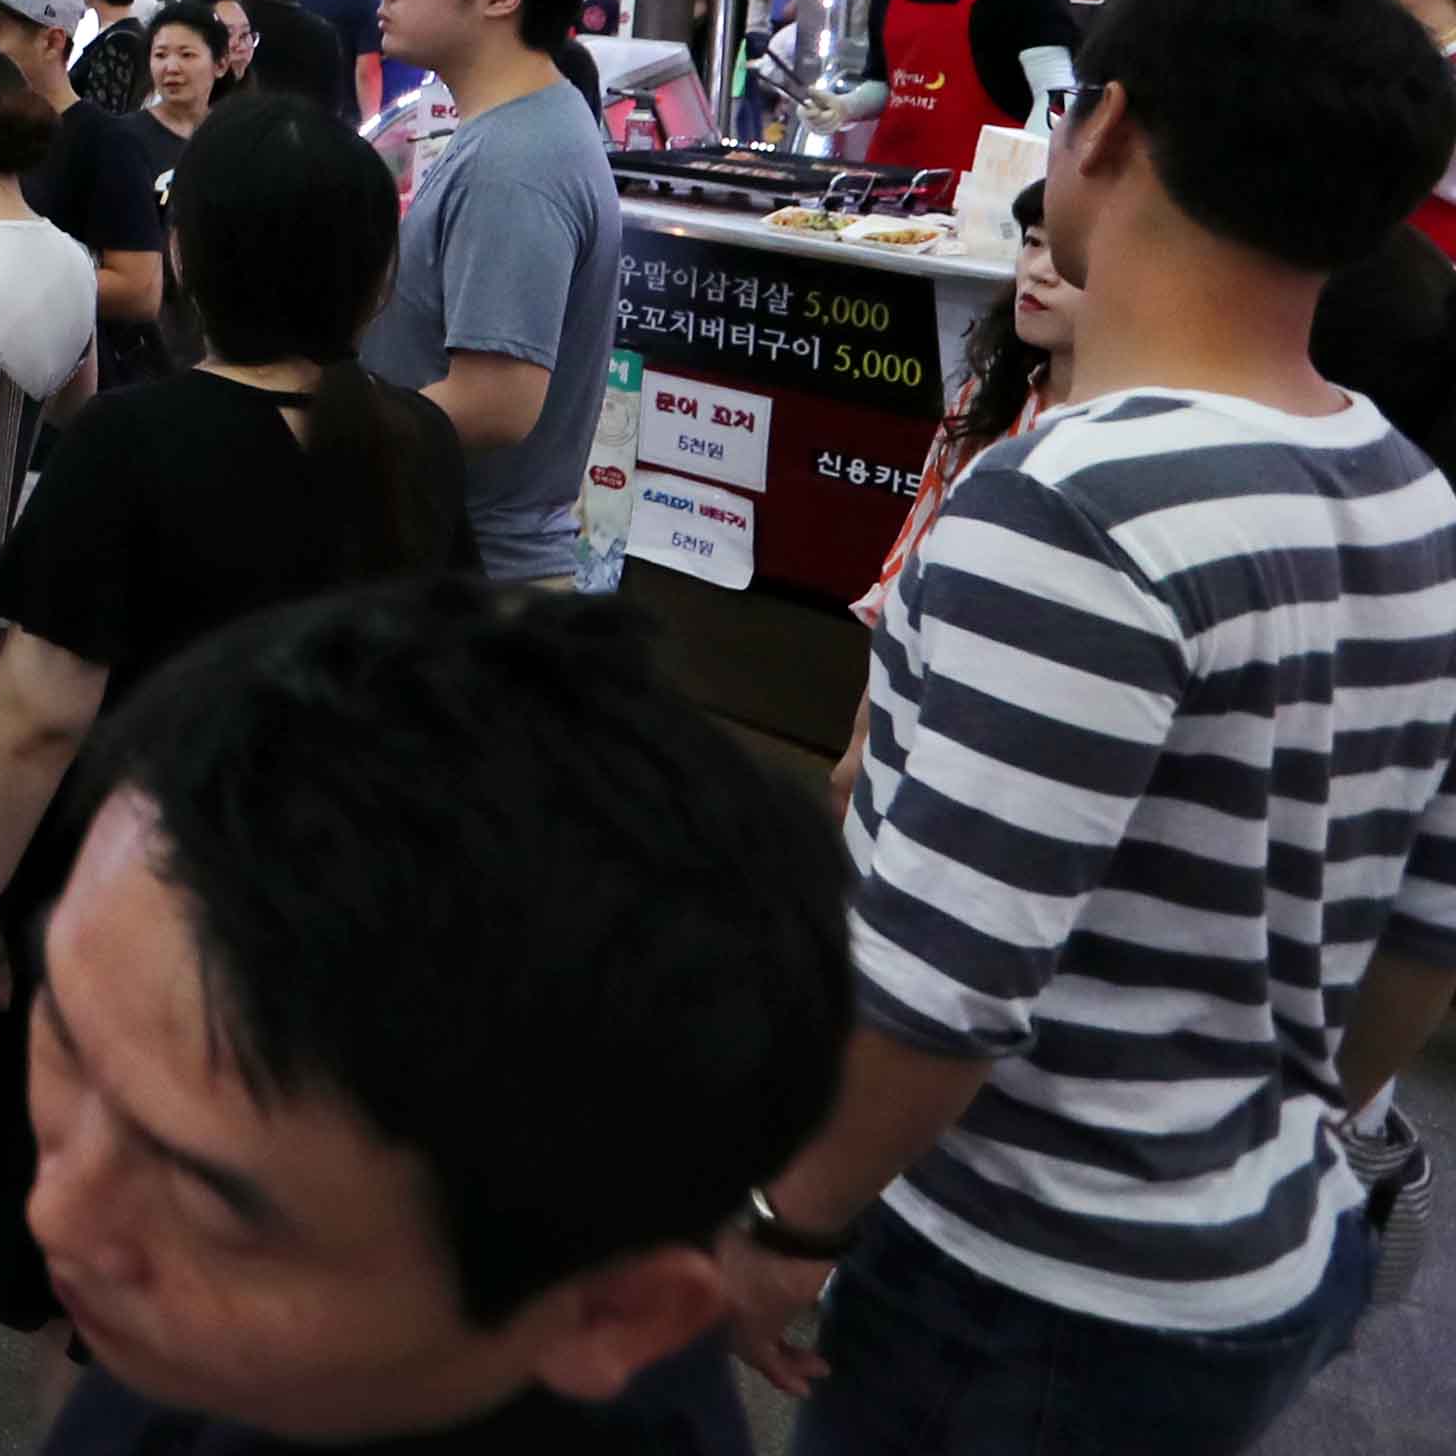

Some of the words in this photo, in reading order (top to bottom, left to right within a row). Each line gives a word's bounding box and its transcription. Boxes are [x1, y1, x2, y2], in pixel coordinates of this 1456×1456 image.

[618, 255, 795, 318] 우말이삼겹살
[802, 290, 890, 332] 5,000
[617, 298, 821, 371] 우꼬치버터구이
[833, 343, 923, 387] 5,000
[656, 391, 699, 420] 문어
[710, 403, 756, 433] 꼬치
[678, 434, 724, 461] 5천원
[816, 450, 926, 496] 신용카드
[672, 531, 715, 558] 5천원
